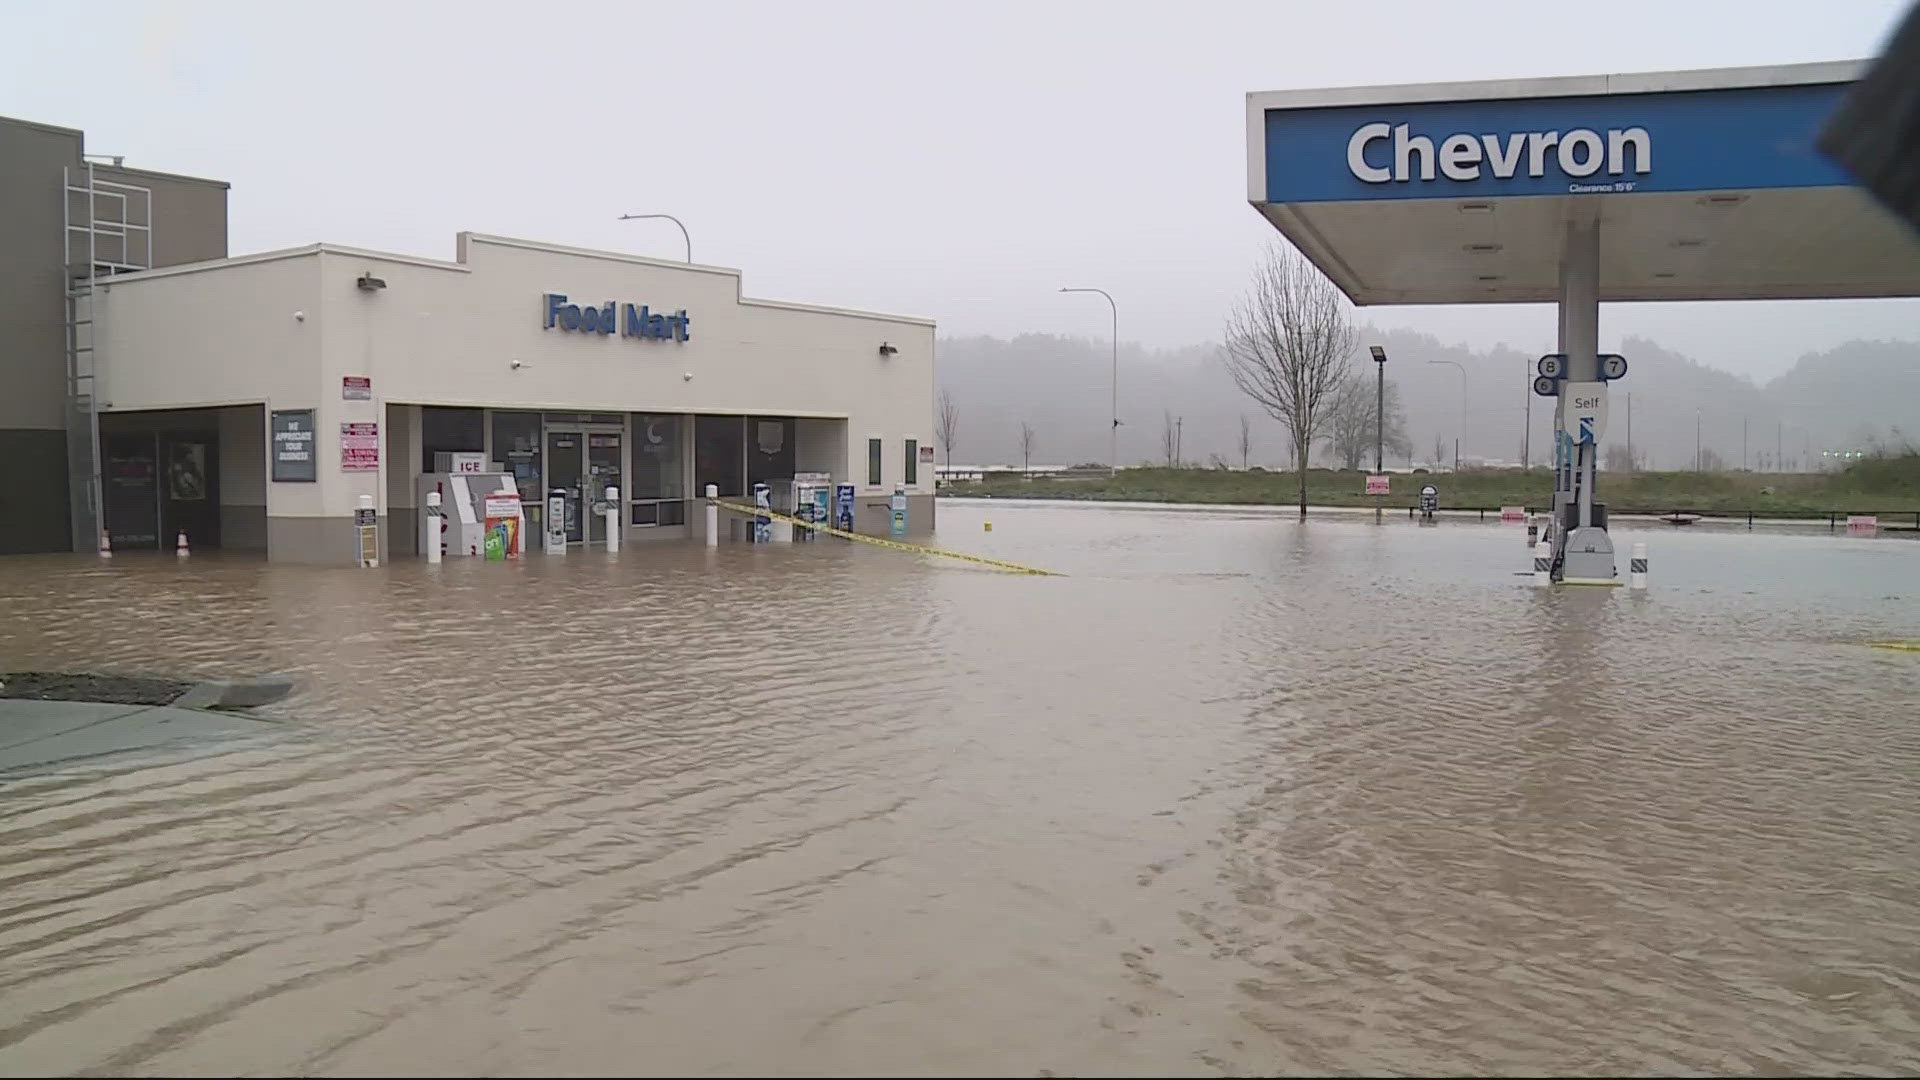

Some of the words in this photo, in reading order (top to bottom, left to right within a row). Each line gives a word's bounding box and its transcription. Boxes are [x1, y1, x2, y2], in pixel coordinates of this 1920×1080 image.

[1347, 122, 1651, 183] Chevron
[1569, 183, 1613, 193] Clearance
[543, 293, 616, 334] Food
[622, 303, 690, 342] Mart
[1546, 361, 1556, 373] 8
[1609, 361, 1618, 373] 7
[1540, 381, 1548, 391] 6
[1575, 397, 1600, 409] Self
[460, 462, 481, 472] ICE
